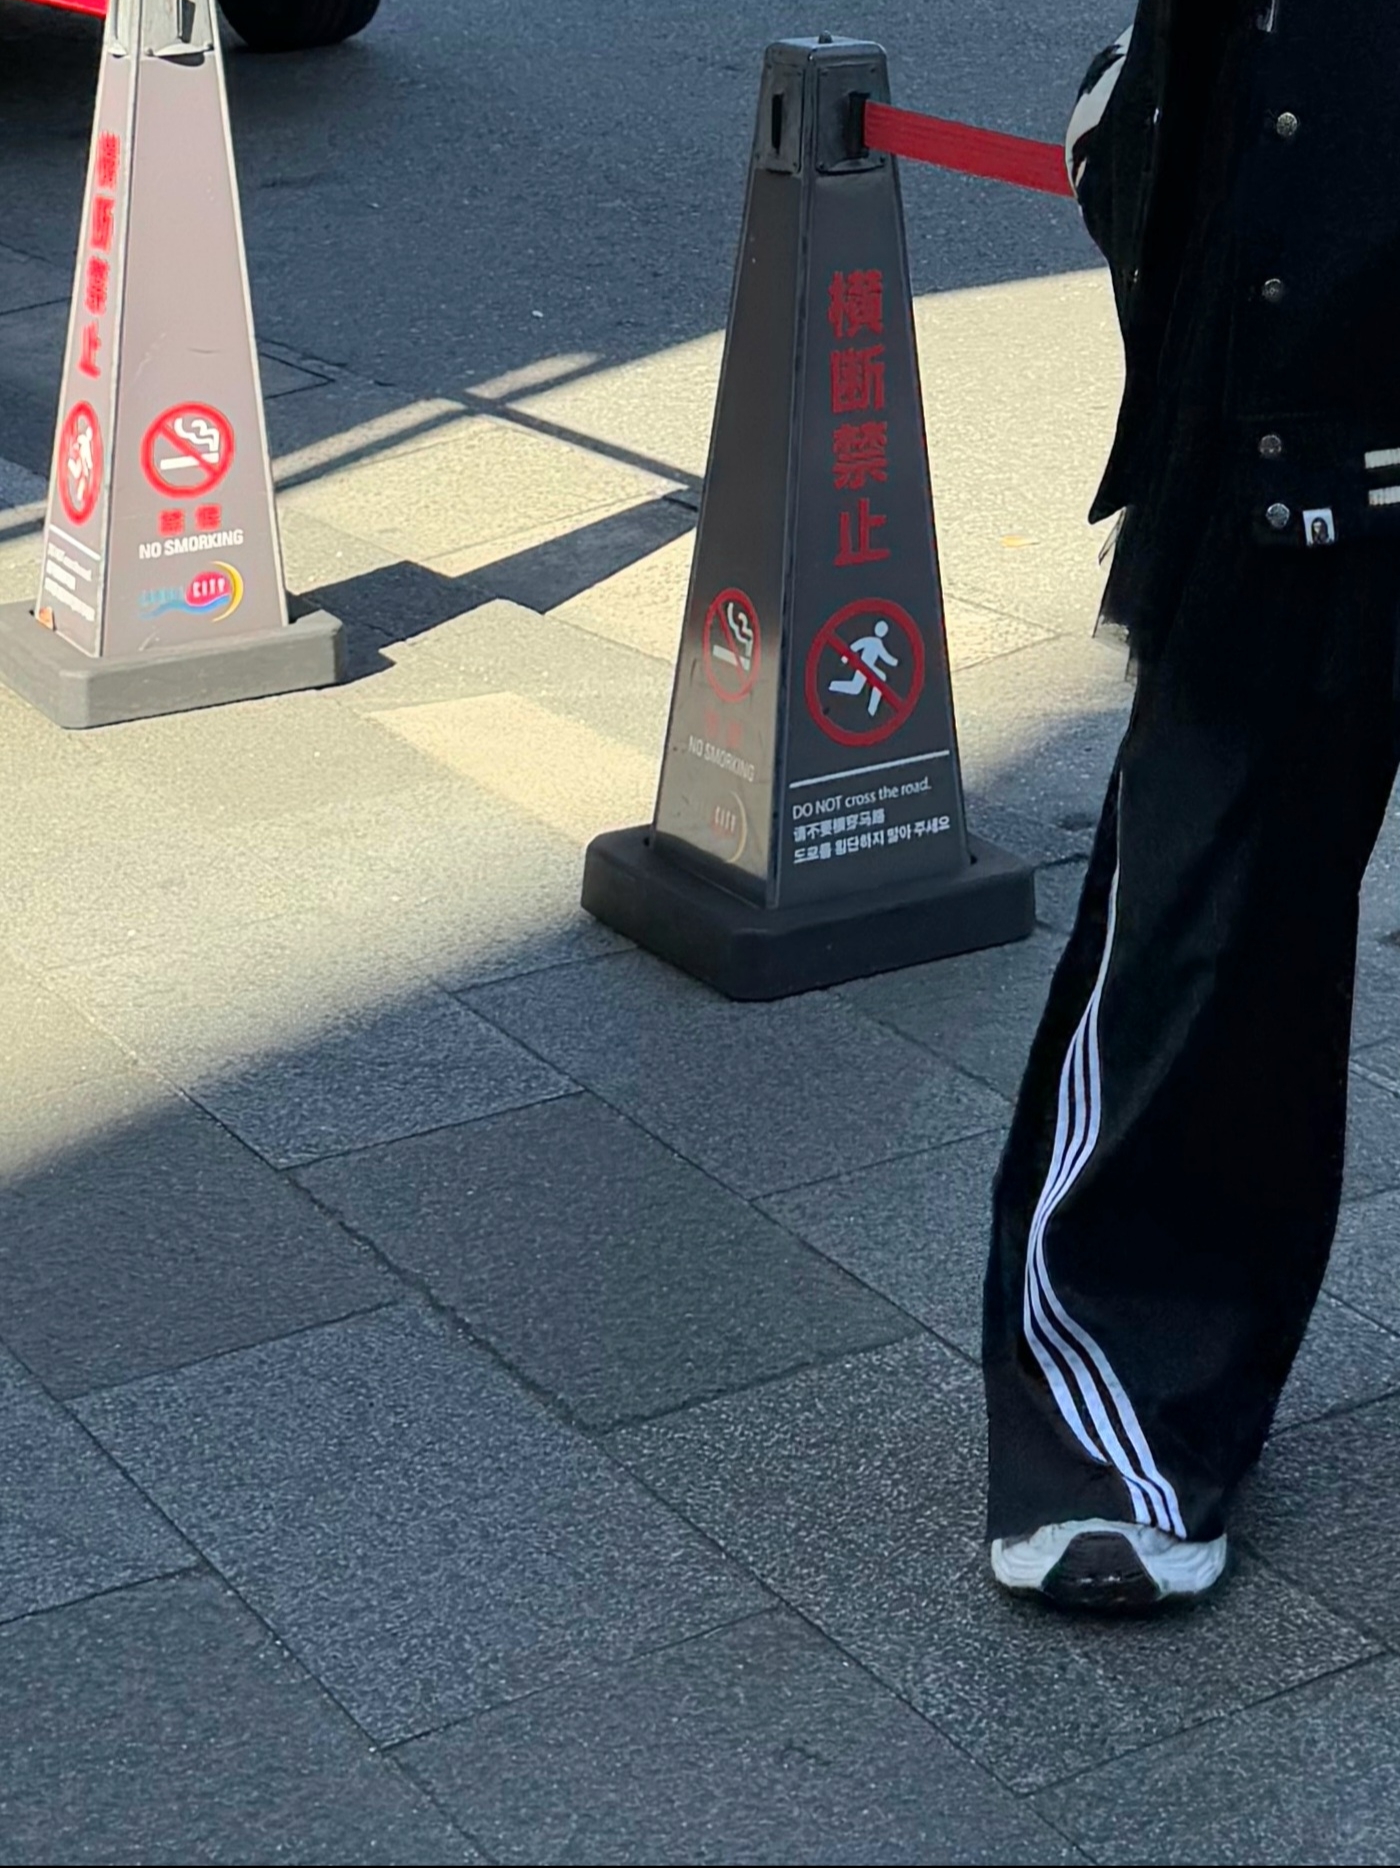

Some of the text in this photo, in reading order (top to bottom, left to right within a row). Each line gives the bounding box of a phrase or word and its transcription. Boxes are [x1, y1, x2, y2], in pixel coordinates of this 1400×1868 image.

[827, 269, 891, 567] 横断禁止
[138, 529, 244, 559] NO SMORKING
[688, 735, 704, 757] NO
[792, 802, 813, 820] DO
[815, 795, 843, 815] NOT
[845, 791, 876, 808] cross
[878, 785, 899, 800] the
